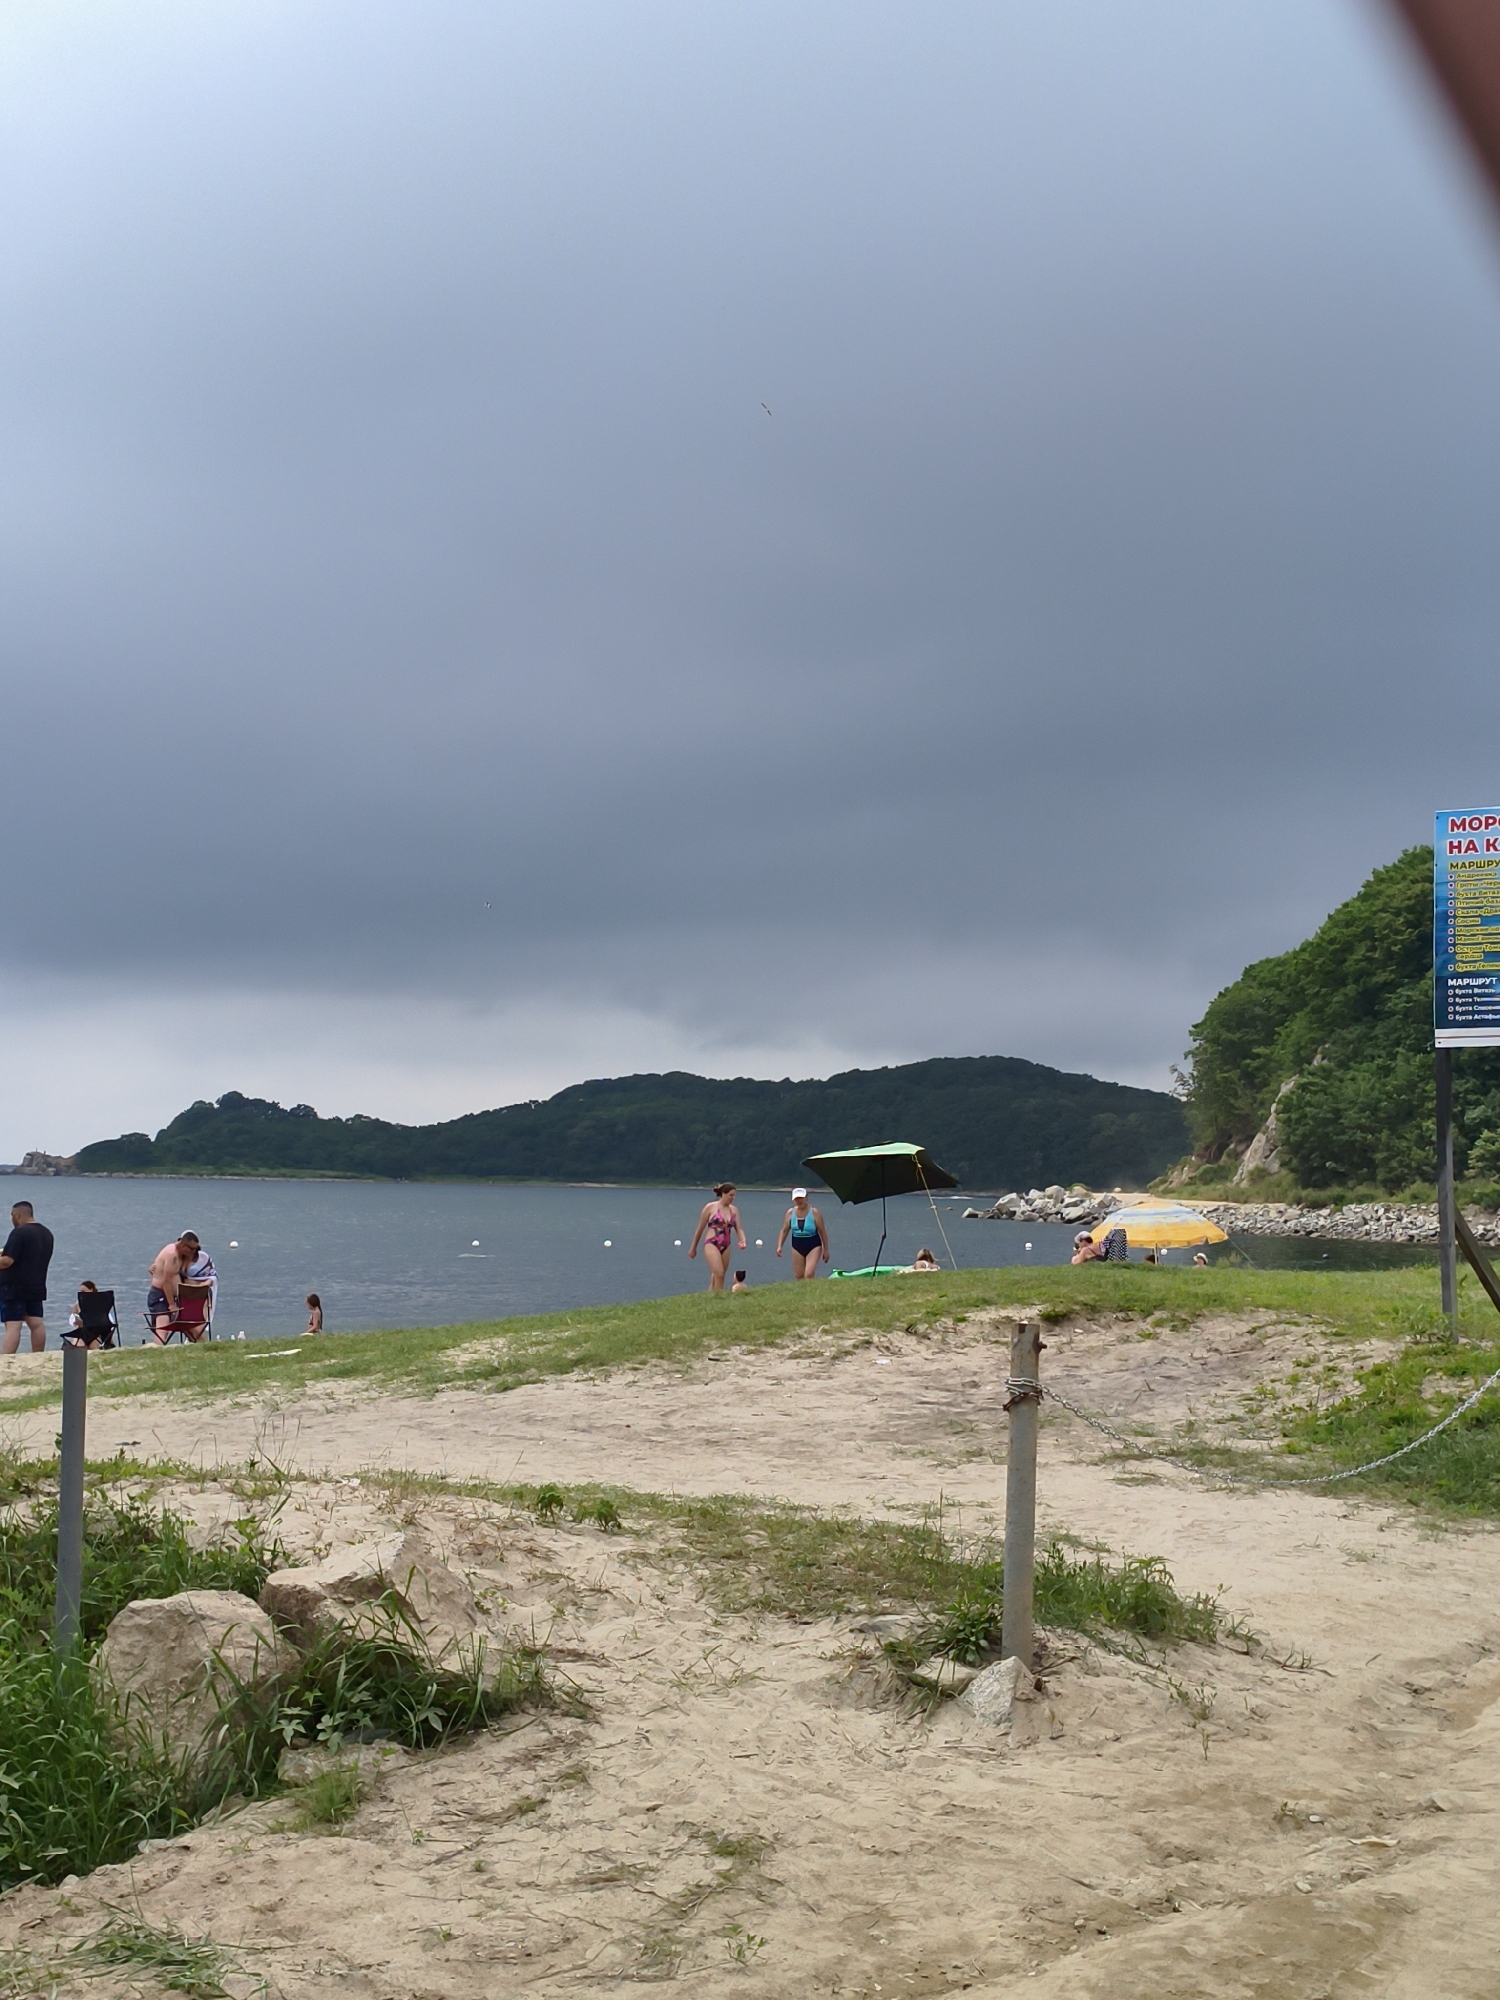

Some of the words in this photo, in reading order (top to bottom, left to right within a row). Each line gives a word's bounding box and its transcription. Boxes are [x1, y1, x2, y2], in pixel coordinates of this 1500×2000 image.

[1448, 839, 1480, 855] НА
[1485, 837, 1500, 853] К
[1448, 977, 1498, 987] МАРШРУТ
